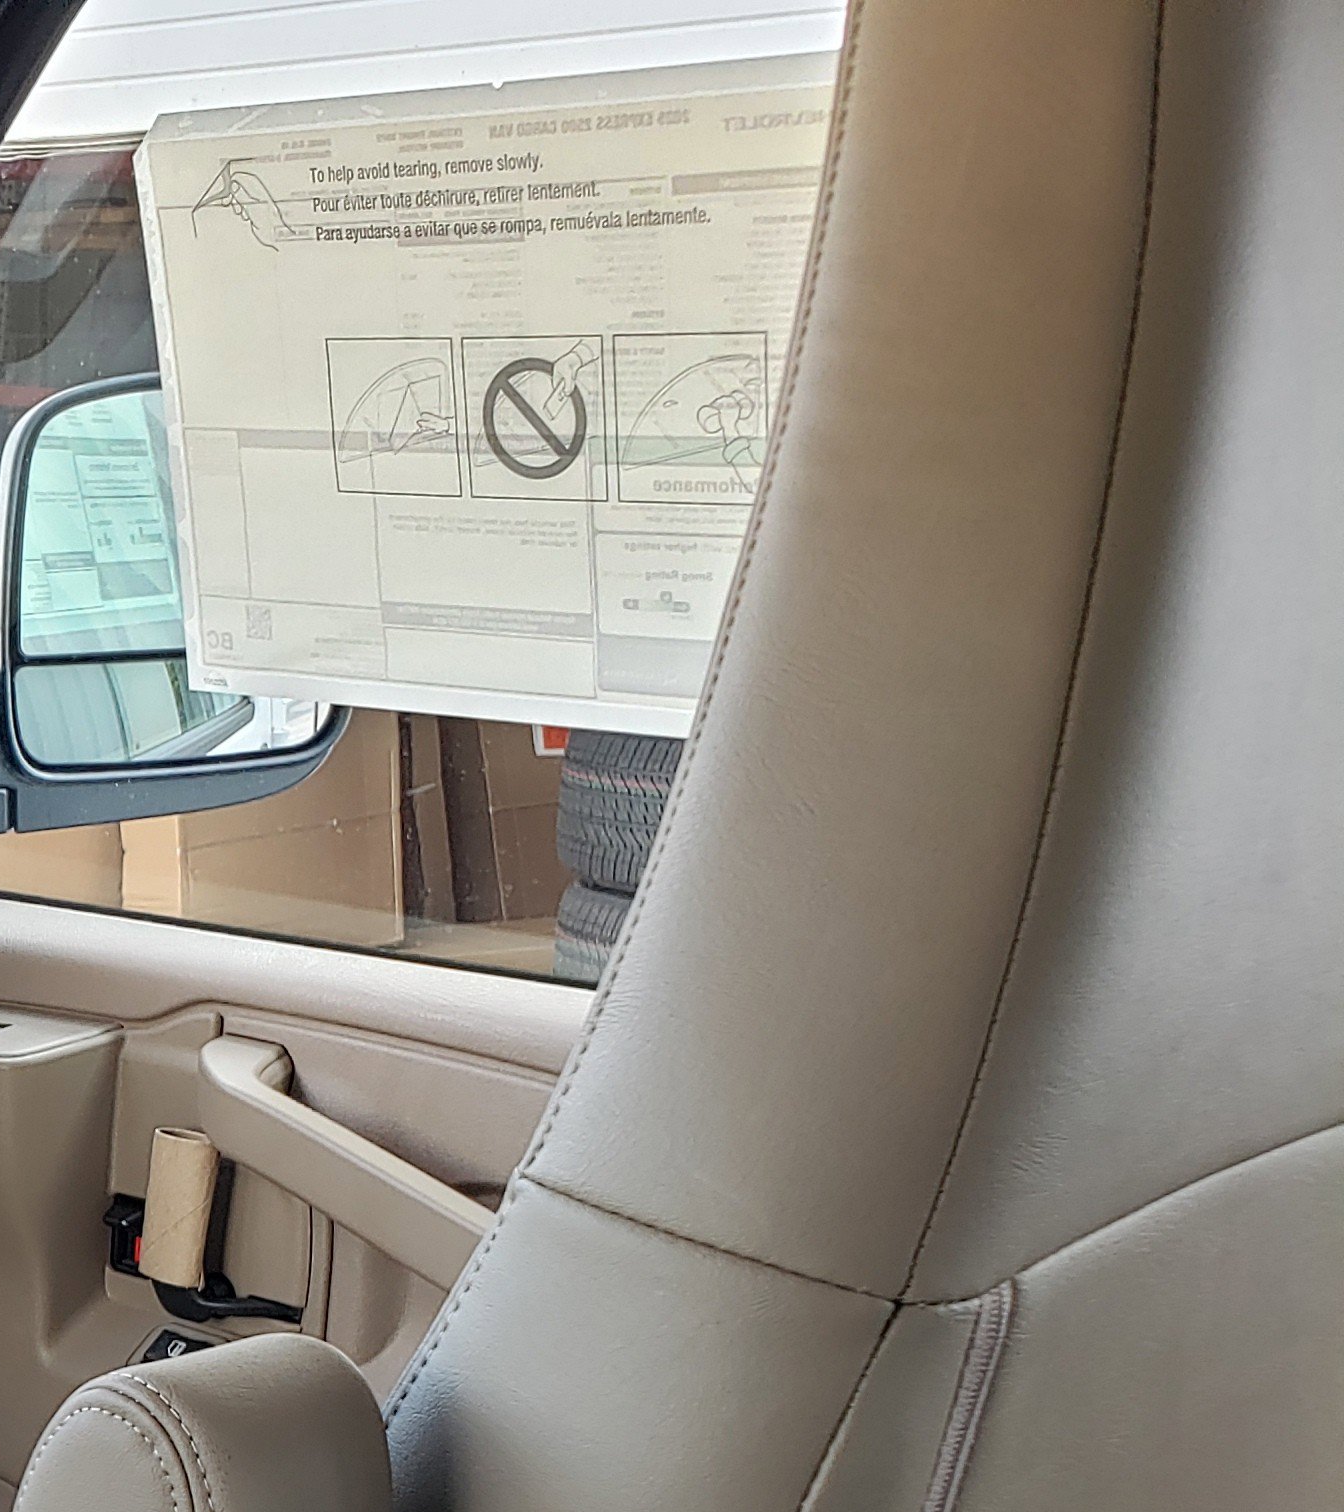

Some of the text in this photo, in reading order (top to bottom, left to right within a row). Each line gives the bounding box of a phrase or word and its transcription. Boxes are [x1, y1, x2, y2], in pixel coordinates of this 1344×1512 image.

[310, 152, 543, 185] To help avoid tearing, remove slowly.
[313, 180, 600, 213] Pour éviter toute déchirure, retirer lentement.
[315, 207, 712, 244] Para ayudarse a evitar que se rompa, remuévala lentamente.
